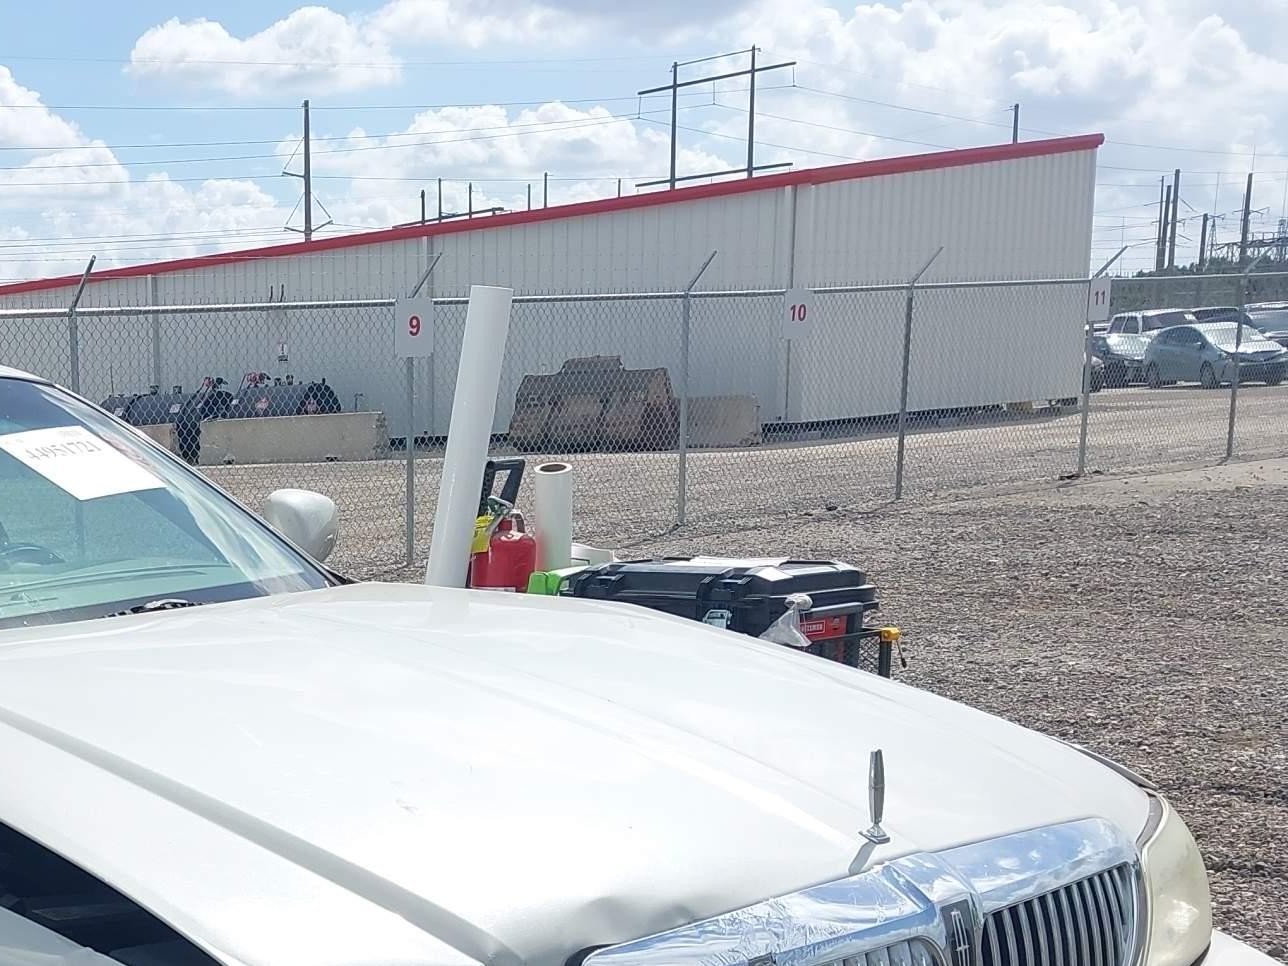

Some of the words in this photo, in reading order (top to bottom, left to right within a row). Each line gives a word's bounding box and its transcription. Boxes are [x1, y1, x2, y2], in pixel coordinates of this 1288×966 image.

[1095, 290, 1106, 306] 11
[790, 303, 807, 322] 10
[409, 315, 421, 337] 9
